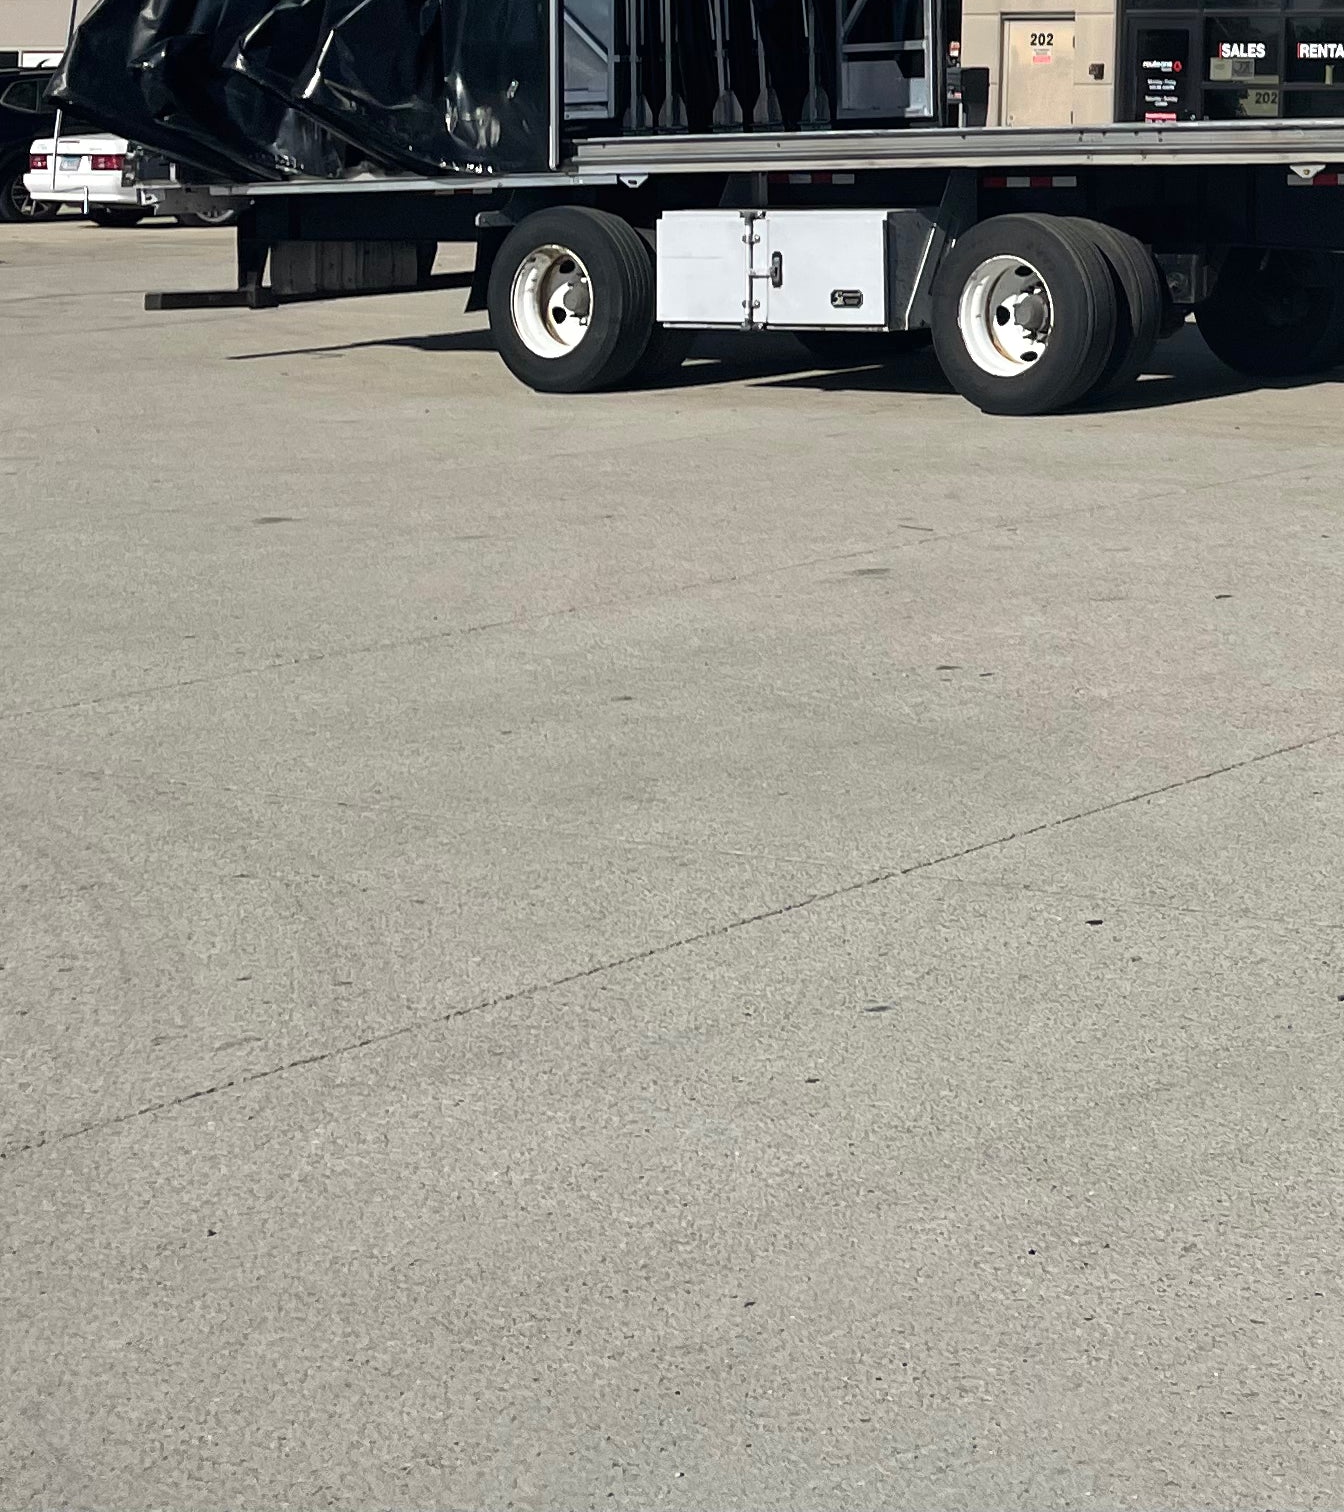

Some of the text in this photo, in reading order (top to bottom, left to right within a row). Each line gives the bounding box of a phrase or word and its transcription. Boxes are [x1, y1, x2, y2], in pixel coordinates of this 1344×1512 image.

[1030, 33, 1054, 46] 202
[1221, 43, 1266, 58] SALES
[1255, 92, 1278, 104] 202
